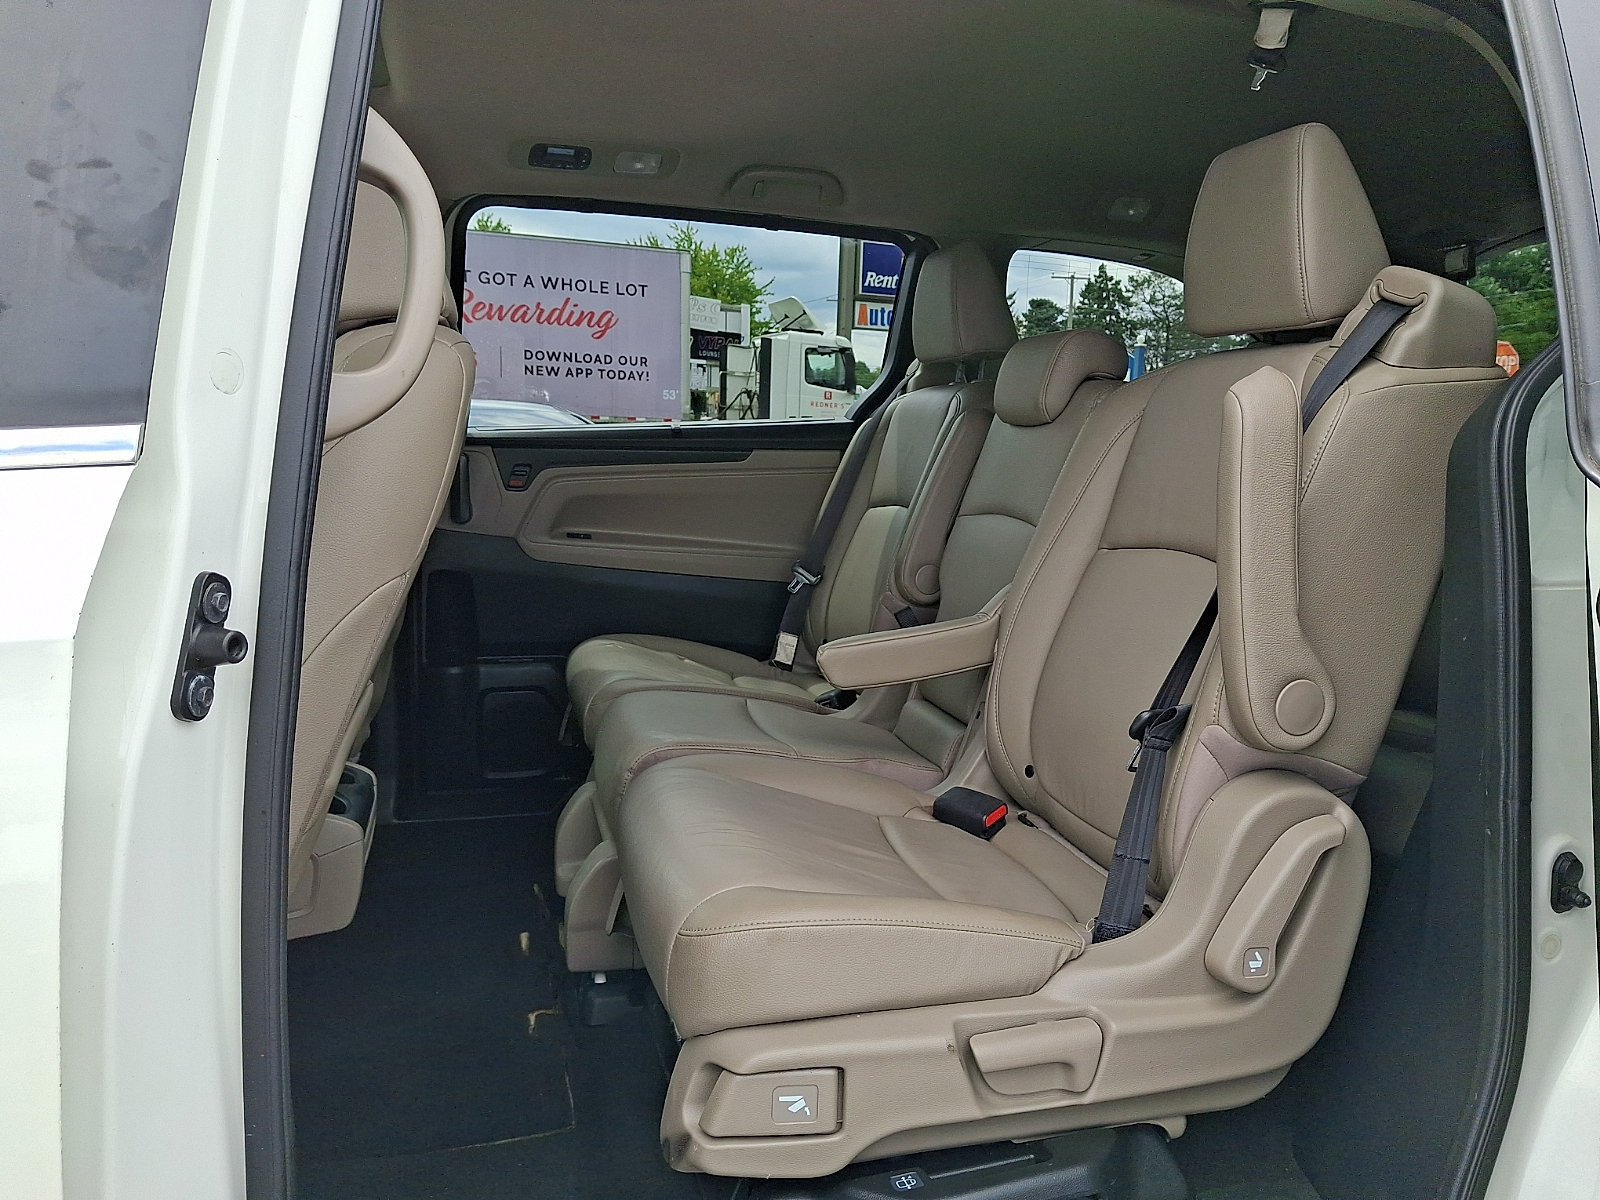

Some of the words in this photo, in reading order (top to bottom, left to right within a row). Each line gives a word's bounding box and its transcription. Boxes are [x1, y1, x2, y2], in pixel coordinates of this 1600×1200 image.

[478, 270, 518, 287] GOT
[523, 274, 536, 288] A
[540, 275, 610, 295] WHOLE
[616, 282, 649, 298] LOT
[863, 271, 900, 289] Rent
[523, 349, 613, 365] DOWNLOAD
[618, 355, 649, 367] OUR
[524, 365, 561, 377] NEW
[565, 367, 594, 379] APP
[597, 368, 651, 382] TODAY!
